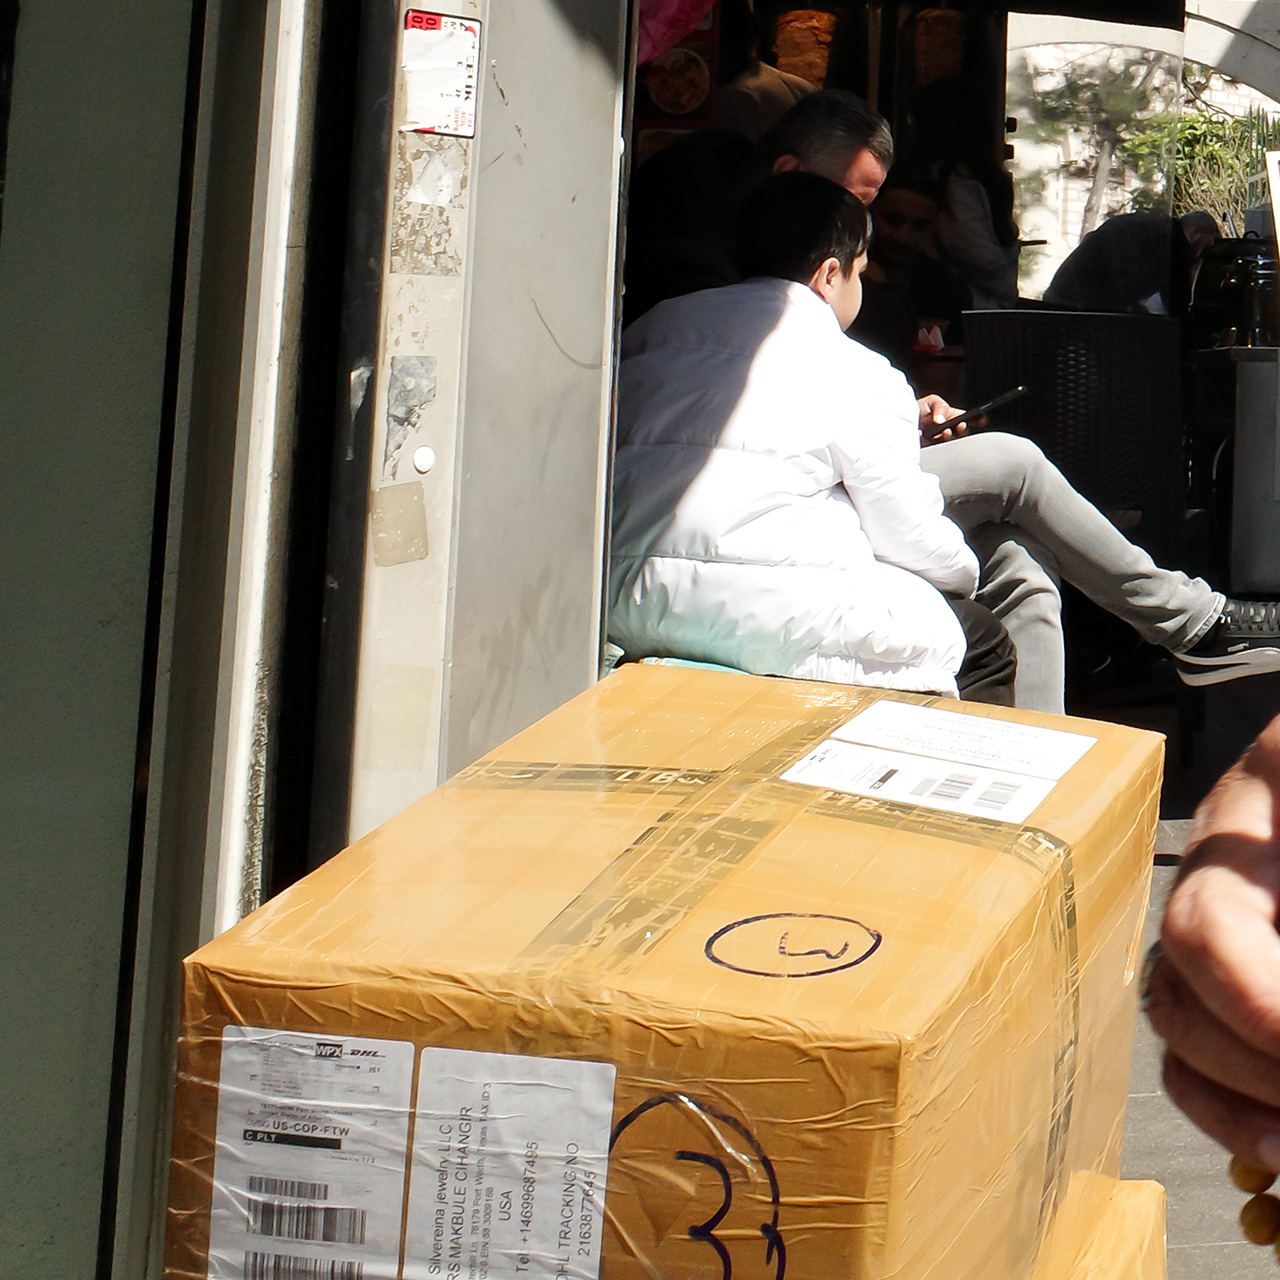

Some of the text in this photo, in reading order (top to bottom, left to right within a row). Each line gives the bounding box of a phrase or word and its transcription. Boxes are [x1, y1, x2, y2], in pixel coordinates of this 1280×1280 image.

[316, 1044, 342, 1058] WPX
[350, 1048, 380, 1058] DHL
[272, 1120, 351, 1137] US-COP-FTW
[454, 1106, 473, 1182] CIHANGIR
[498, 1190, 513, 1221] USA
[558, 1170, 577, 1249] TRACKING
[675, 1150, 733, 1280] 3
[428, 1207, 446, 1275] Silvereina
